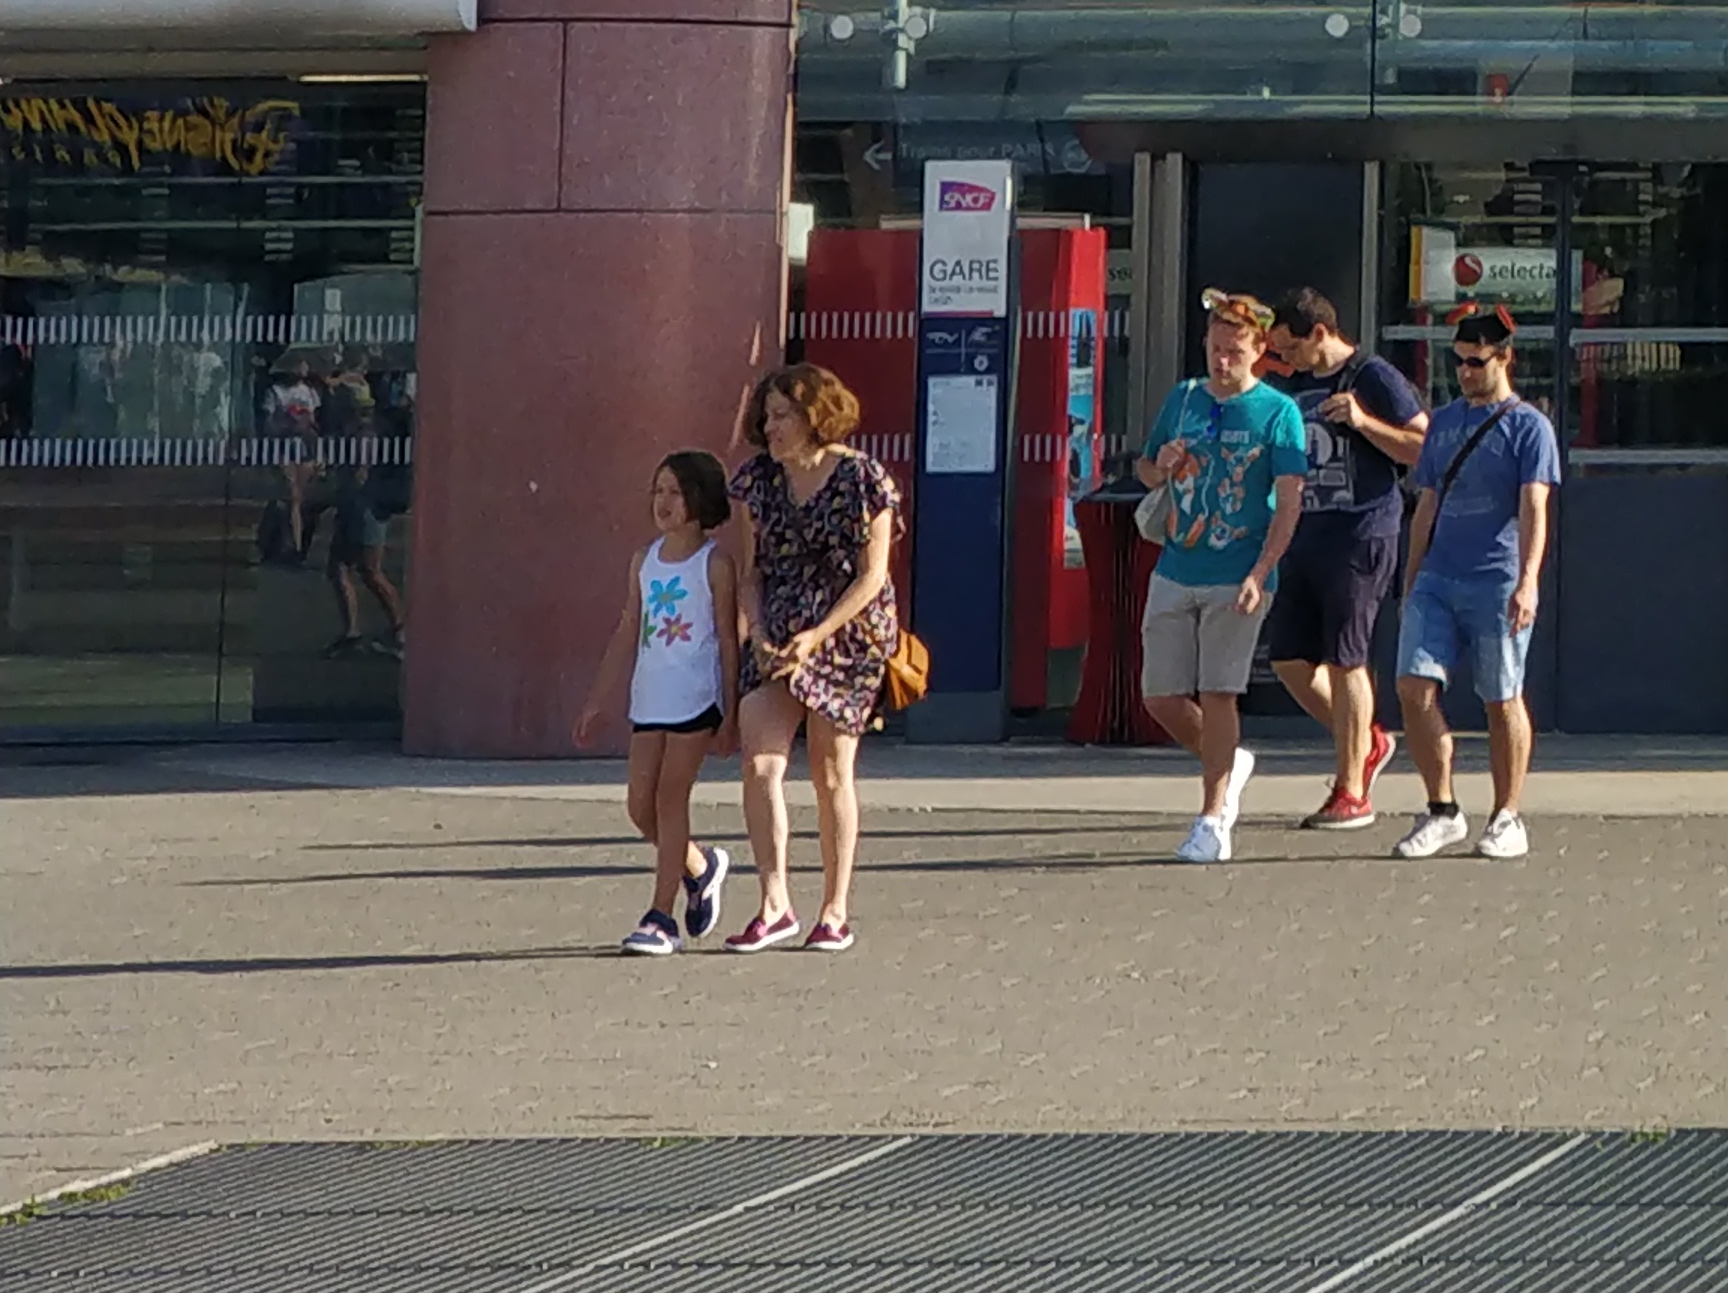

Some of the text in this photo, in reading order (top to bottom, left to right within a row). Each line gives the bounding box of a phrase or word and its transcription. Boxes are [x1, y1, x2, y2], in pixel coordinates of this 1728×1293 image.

[943, 191, 994, 211] SNCF
[929, 258, 1000, 282] GARE
[1488, 261, 1557, 281] selecta
